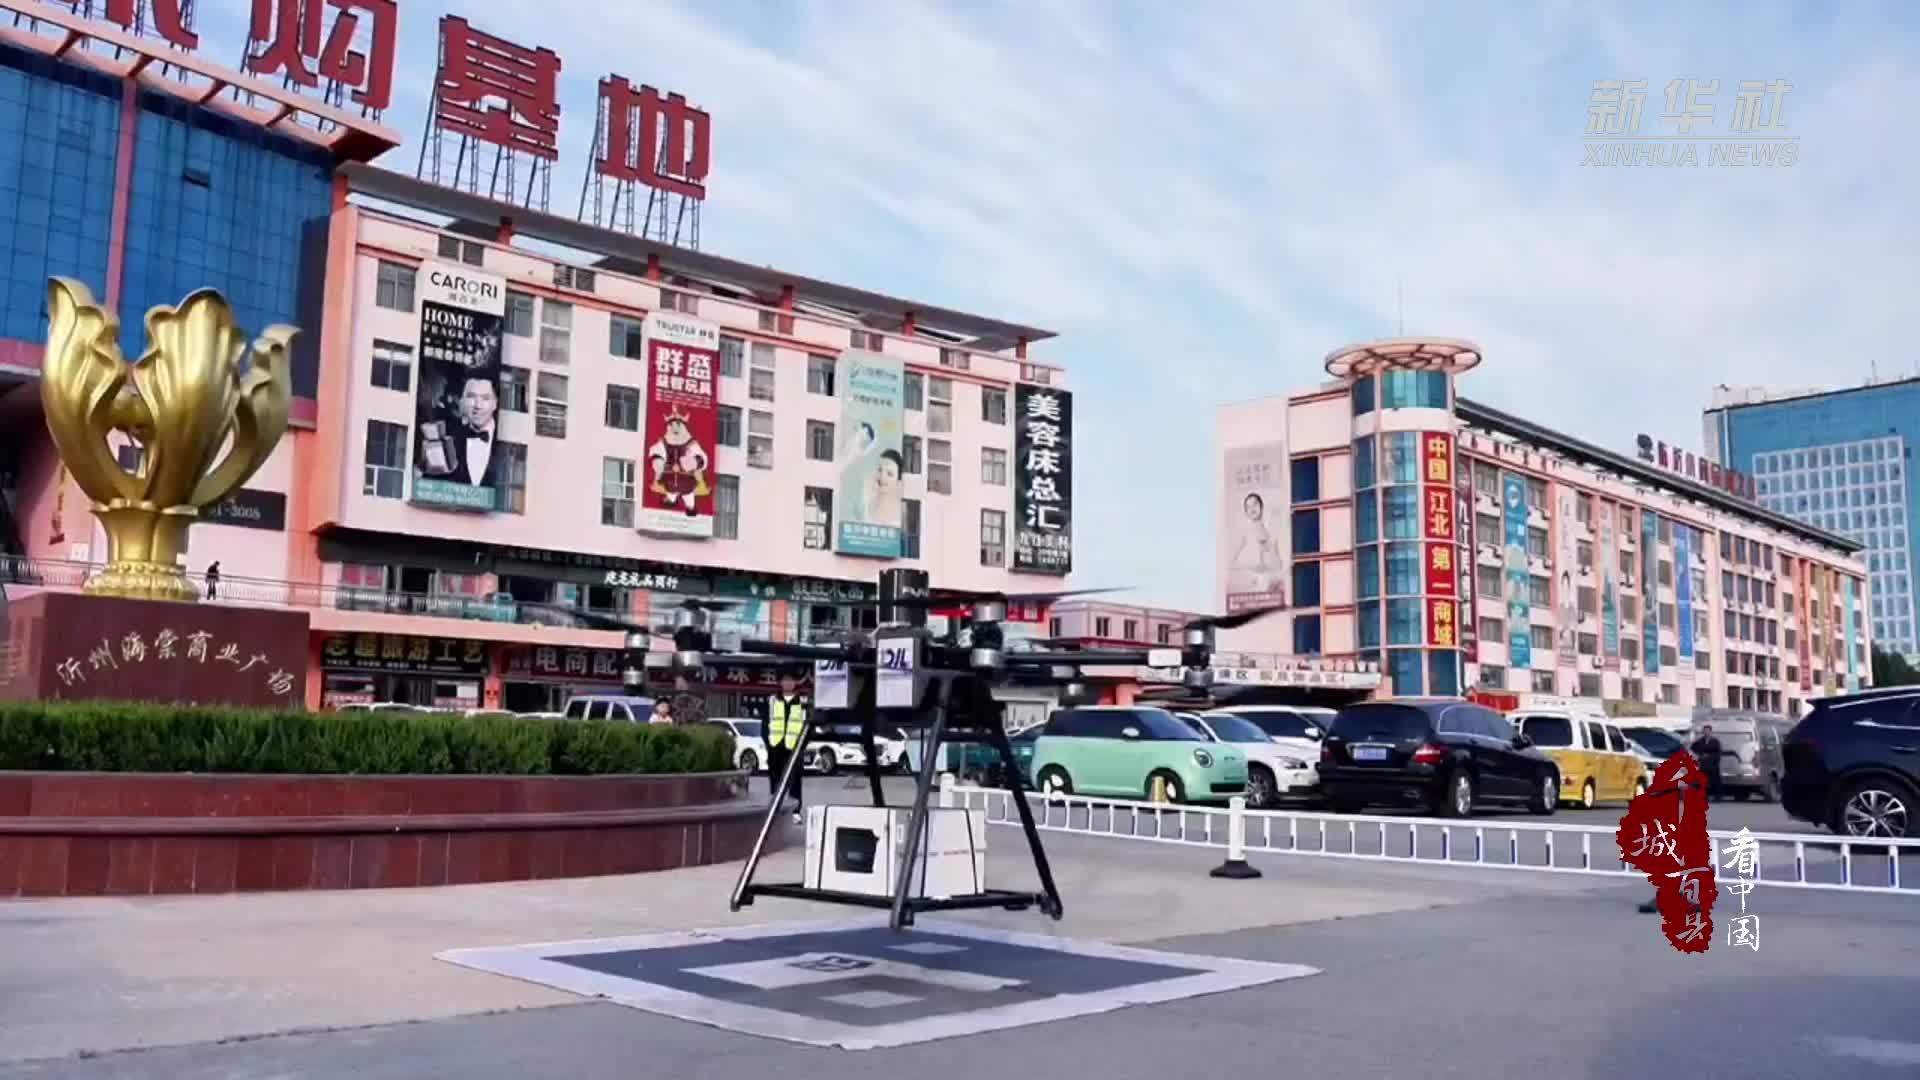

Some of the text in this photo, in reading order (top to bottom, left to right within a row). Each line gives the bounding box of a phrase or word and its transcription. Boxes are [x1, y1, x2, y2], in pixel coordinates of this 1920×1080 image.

[60, 0, 710, 199] 购基地
[424, 307, 474, 330] HOME
[430, 271, 498, 299] CARORI
[655, 345, 712, 381] 群盛
[1025, 392, 1062, 530] 美容床总汇
[1427, 435, 1453, 647] 中国江北第一商城
[55, 628, 296, 696] 沂州海棠商业广场
